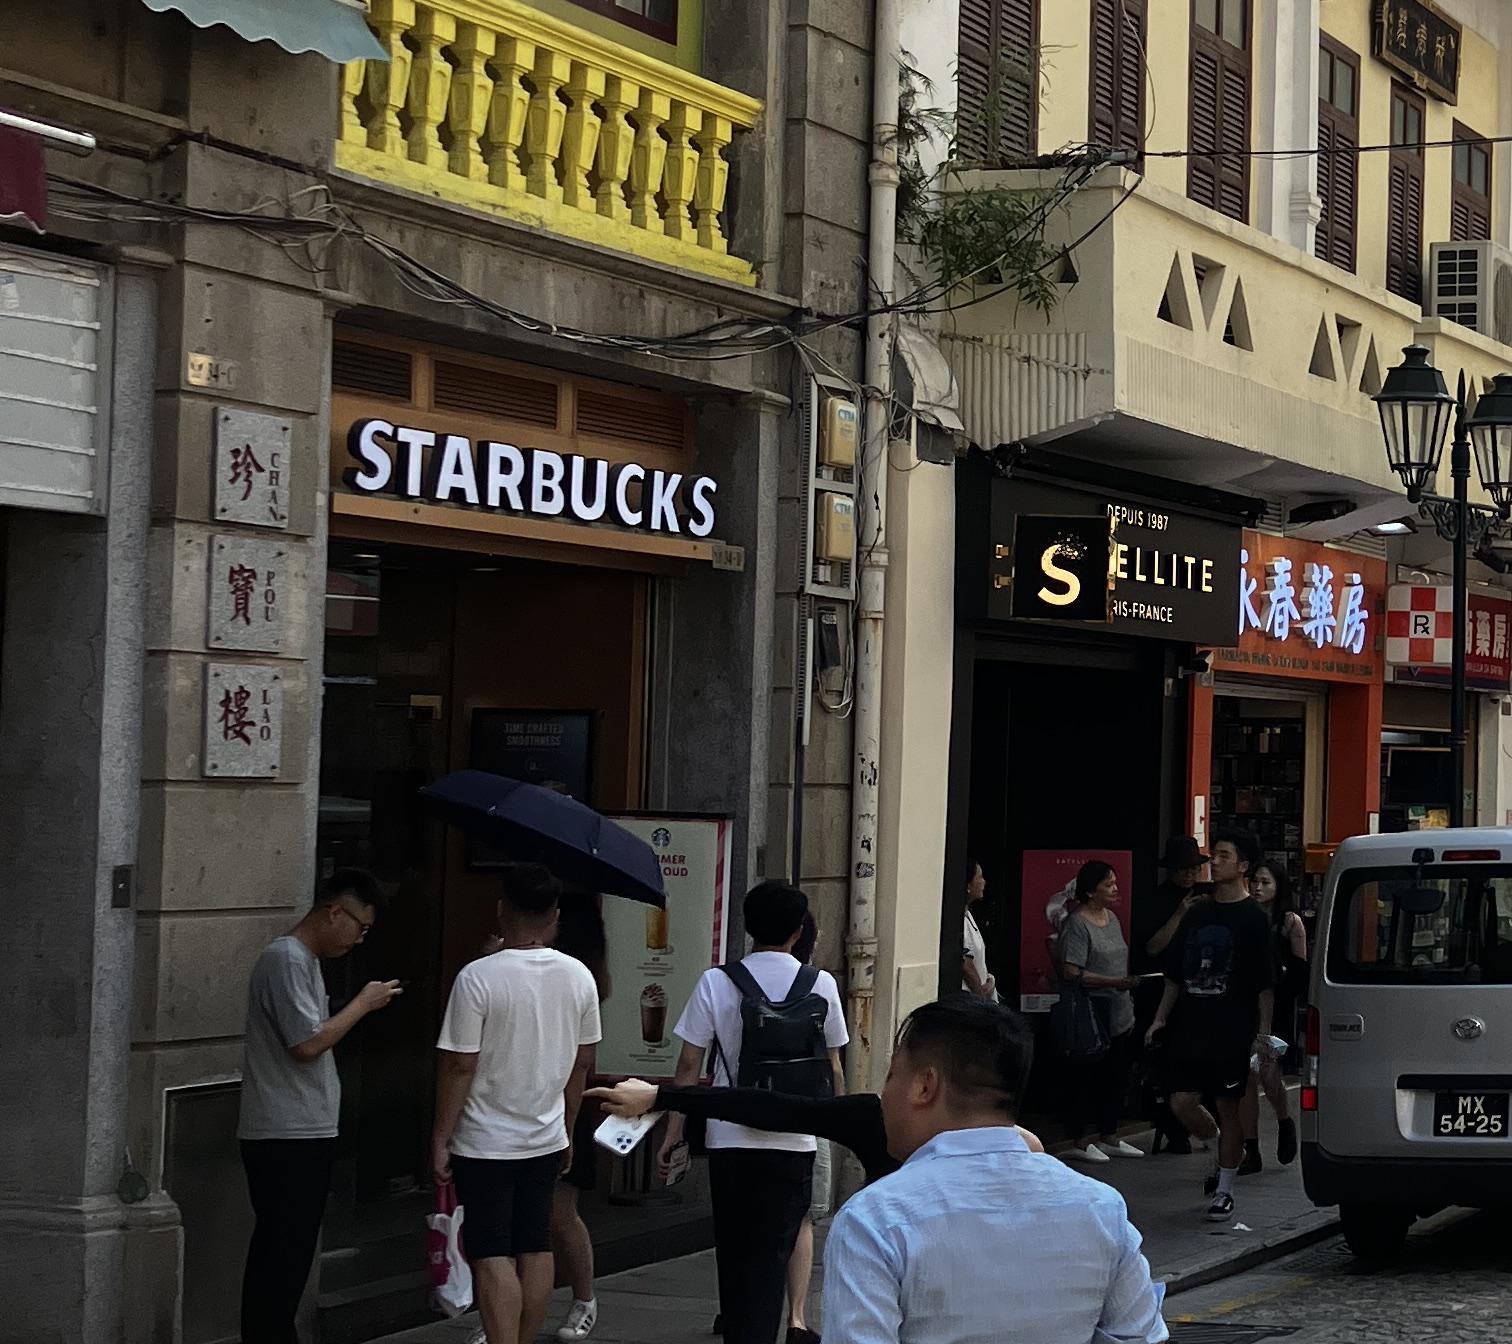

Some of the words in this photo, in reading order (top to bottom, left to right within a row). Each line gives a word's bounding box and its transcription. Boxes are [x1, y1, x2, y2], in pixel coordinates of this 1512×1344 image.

[228, 444, 265, 501] 珍
[269, 452, 282, 521] CHAN
[354, 419, 718, 537] STARBUCKS
[1107, 504, 1143, 526] DEPUIS
[1147, 512, 1169, 531] 1987
[1116, 543, 1213, 593] ELLITE
[228, 563, 257, 626] 寶
[218, 685, 257, 746] 樓
[259, 689, 272, 741] LAO
[662, 866, 689, 877] OUD
[1439, 1114, 1502, 1135] 54-25
[1458, 1095, 1485, 1114] MX
